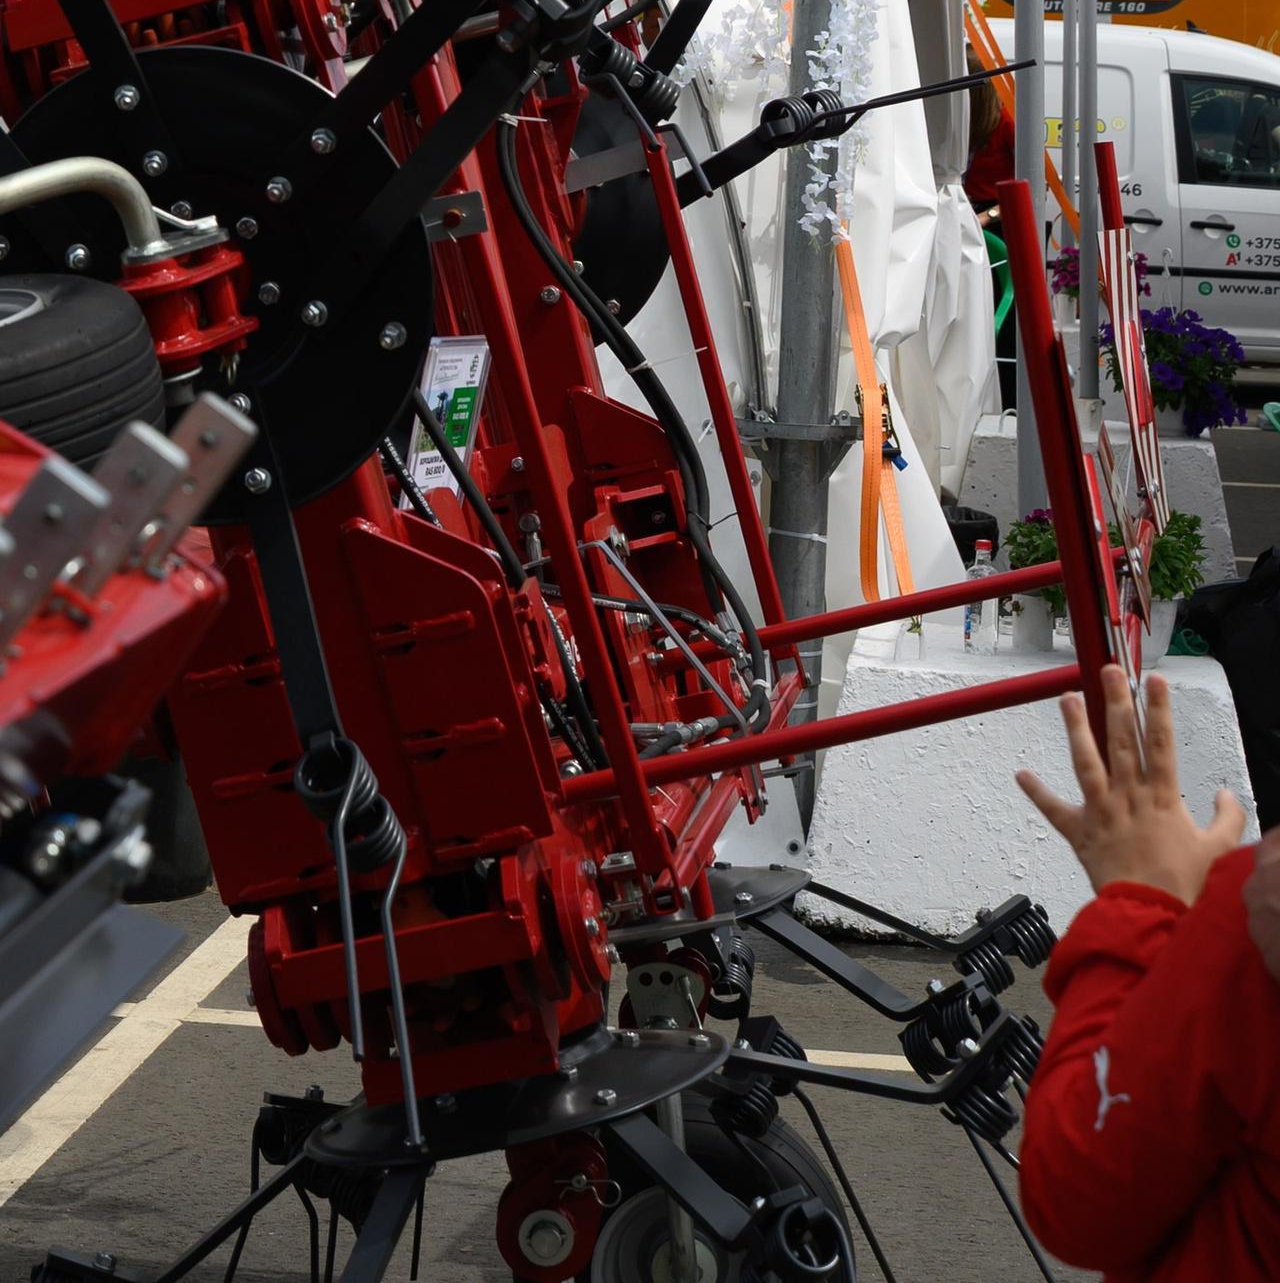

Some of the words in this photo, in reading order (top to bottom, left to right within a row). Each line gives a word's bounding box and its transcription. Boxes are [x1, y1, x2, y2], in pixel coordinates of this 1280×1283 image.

[1118, 1, 1146, 13] 160
[1245, 237, 1280, 250] +375
[1245, 254, 1280, 268] +375
